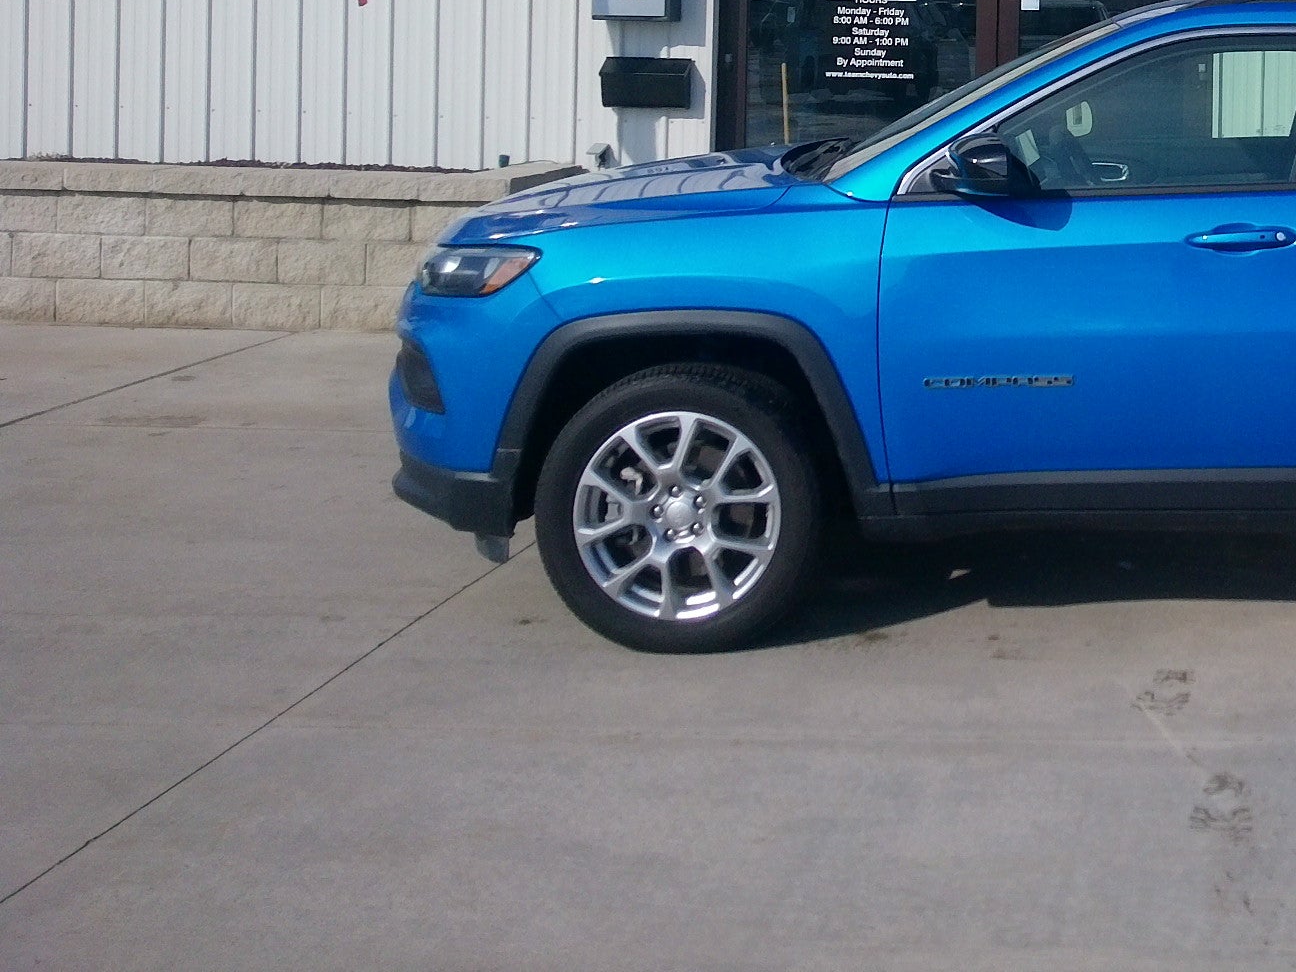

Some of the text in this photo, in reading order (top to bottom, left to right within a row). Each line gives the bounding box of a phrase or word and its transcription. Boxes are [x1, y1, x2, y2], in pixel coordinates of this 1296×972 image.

[837, 7, 872, 16] Monday
[878, 7, 905, 17] Friday
[833, 16, 852, 24] 8:00
[853, 16, 868, 25] AM
[874, 17, 894, 25] 6:00
[895, 17, 909, 26] PM
[852, 27, 889, 37] Saturday
[832, 36, 851, 45] 9:00
[853, 37, 867, 45] AM
[875, 37, 893, 46] 1:00
[895, 38, 909, 46] PM
[854, 48, 886, 58] Sunday
[836, 57, 904, 68] By Appointment
[923, 374, 1075, 388] COMPASS
